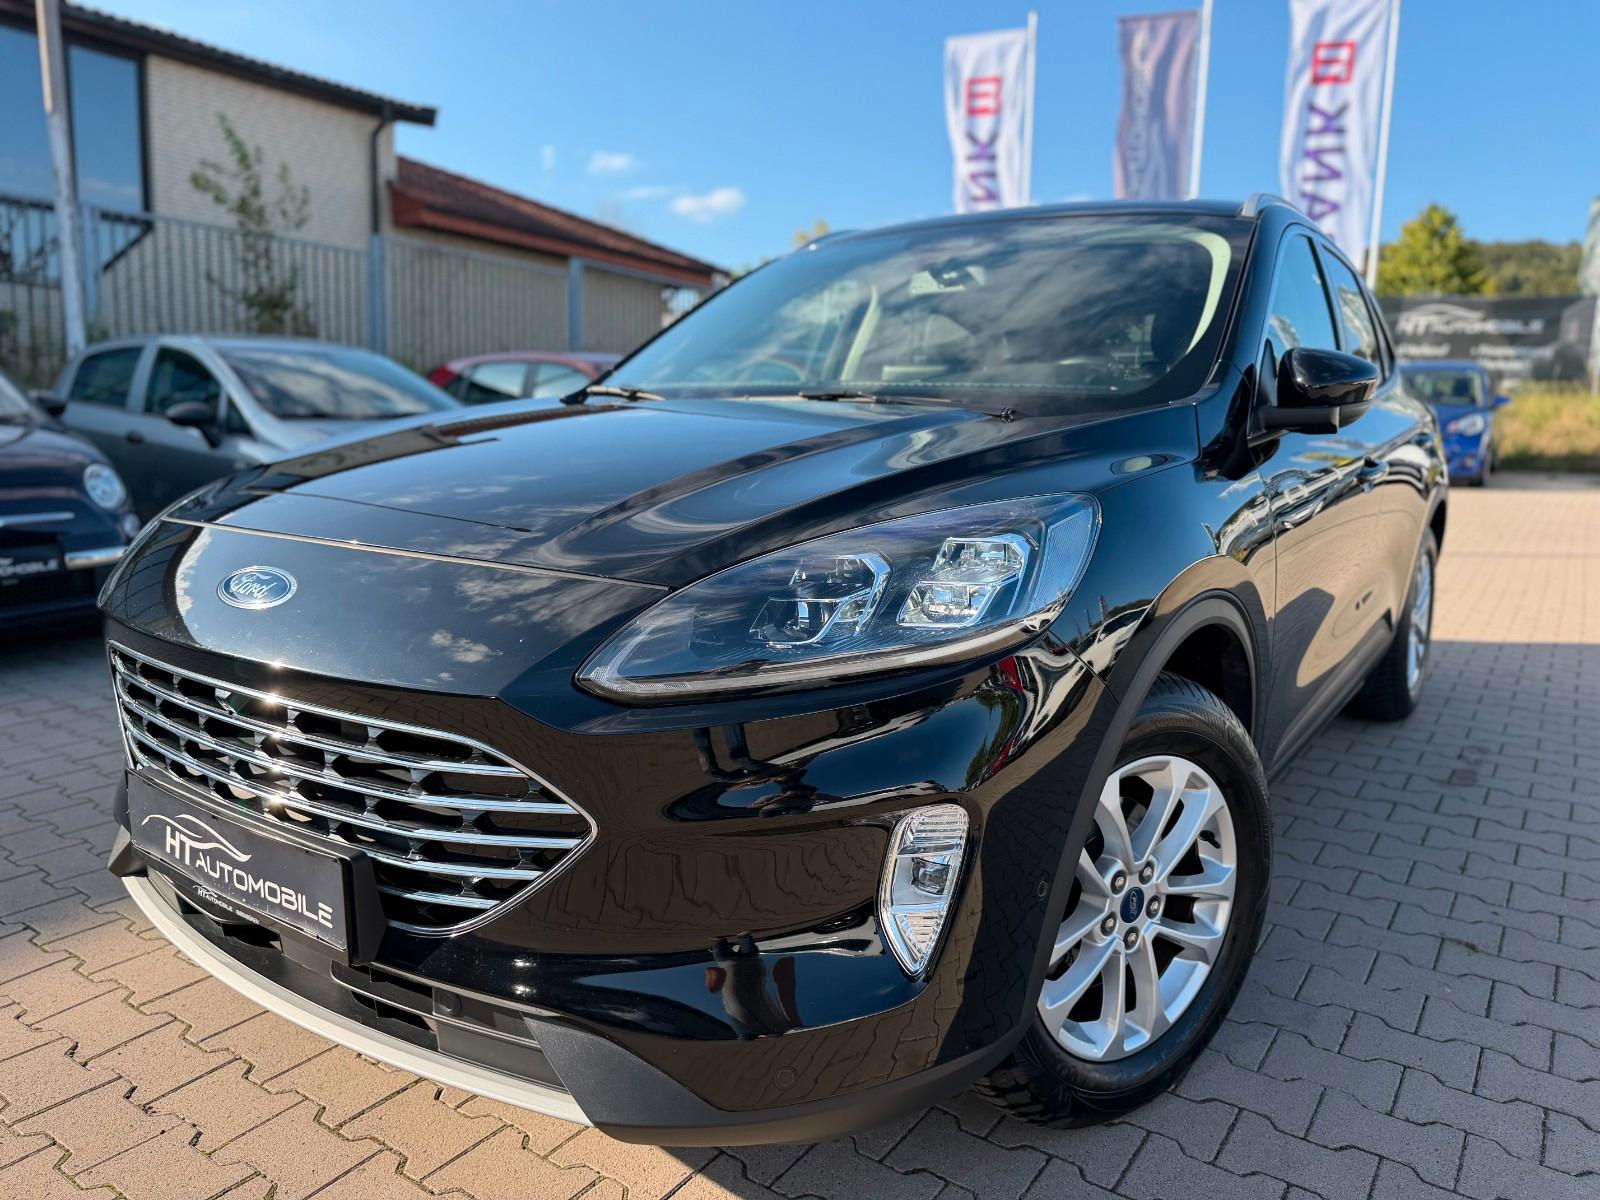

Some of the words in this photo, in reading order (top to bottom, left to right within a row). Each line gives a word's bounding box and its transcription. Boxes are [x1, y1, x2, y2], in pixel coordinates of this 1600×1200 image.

[230, 572, 278, 598] Ford
[166, 825, 196, 865] HT
[196, 851, 333, 928] AUTOMOBILE
